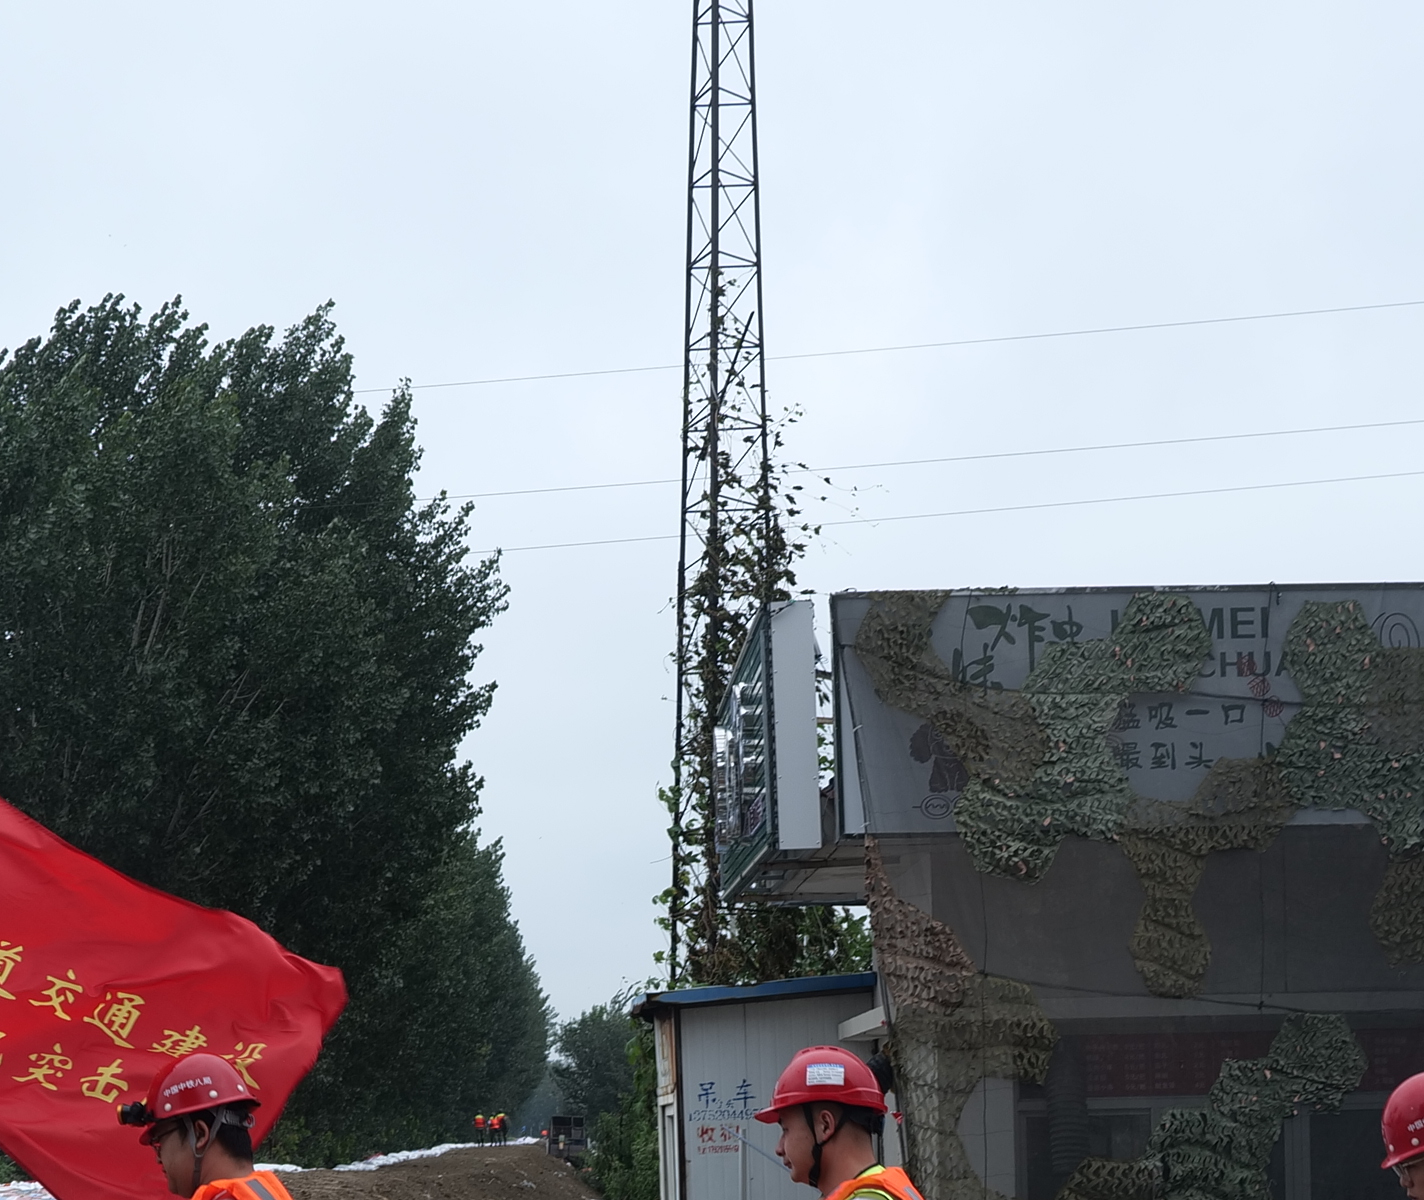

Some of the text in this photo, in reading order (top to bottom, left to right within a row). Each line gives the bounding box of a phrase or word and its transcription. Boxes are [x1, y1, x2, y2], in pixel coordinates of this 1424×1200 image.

[163, 1076, 212, 1097] 中国中铁八局
